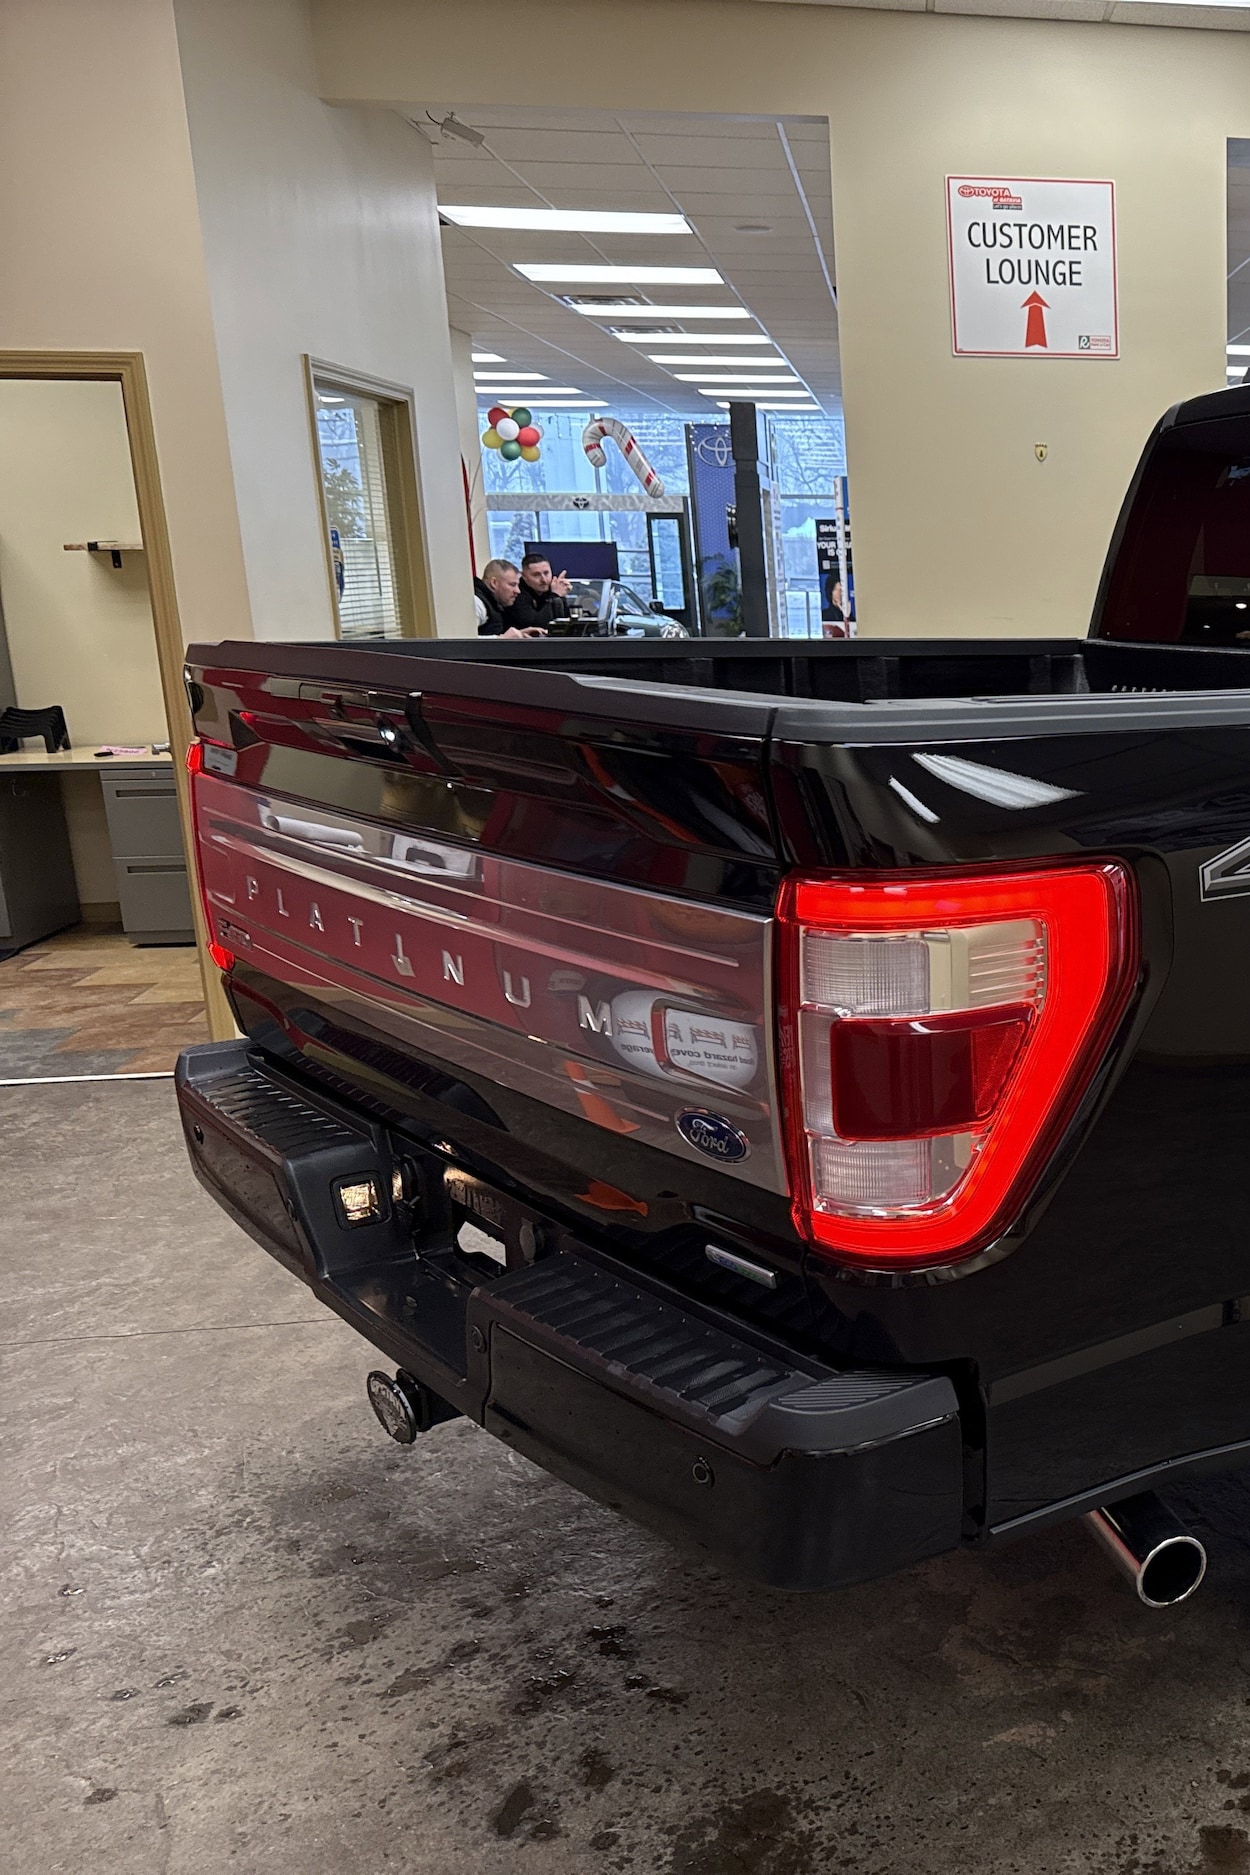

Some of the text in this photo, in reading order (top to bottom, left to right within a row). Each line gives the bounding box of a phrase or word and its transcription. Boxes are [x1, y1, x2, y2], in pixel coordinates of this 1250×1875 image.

[974, 188, 1010, 197] TOYOTA
[967, 221, 1098, 251] CUSTOMER
[986, 258, 1083, 287] LOUNGE
[817, 541, 836, 549] YOUR
[246, 874, 613, 1037] PLATINUM
[689, 1118, 730, 1154] Ford
